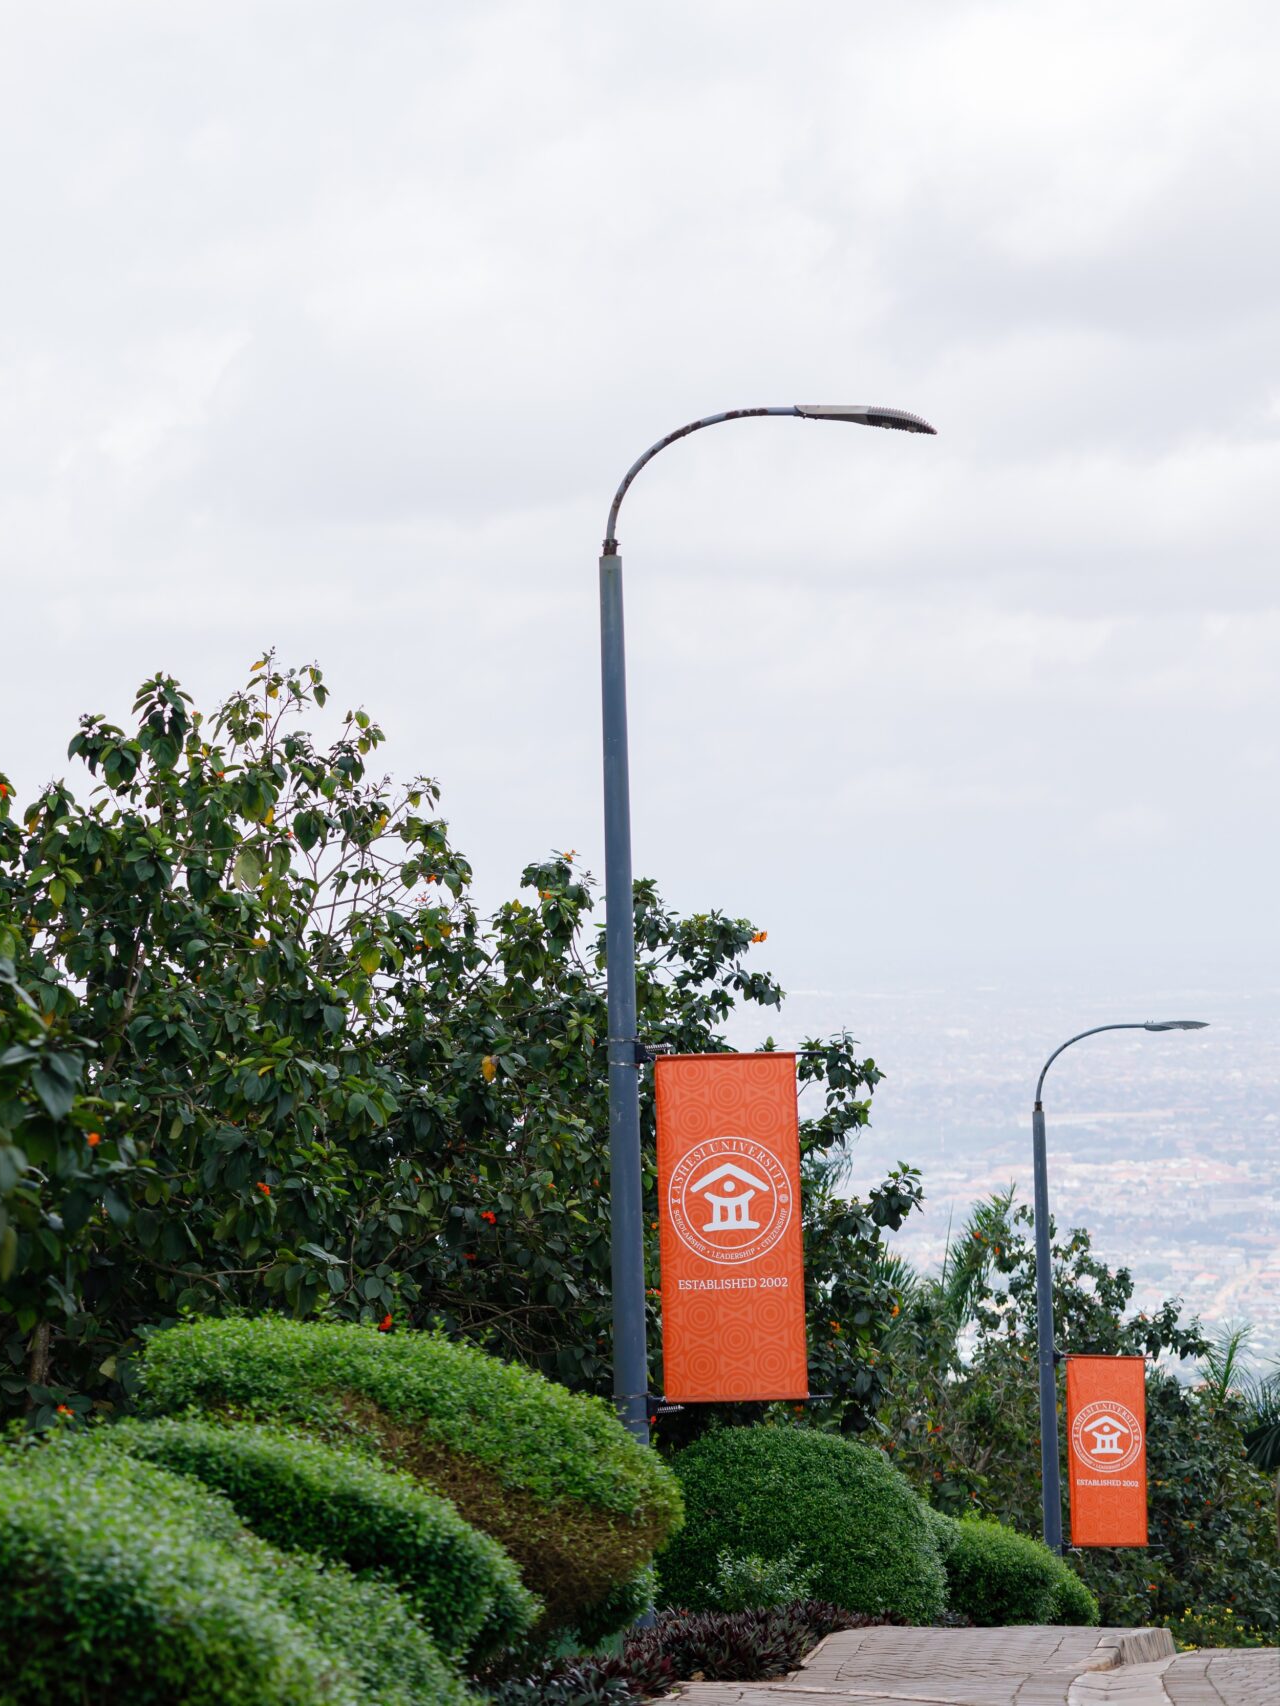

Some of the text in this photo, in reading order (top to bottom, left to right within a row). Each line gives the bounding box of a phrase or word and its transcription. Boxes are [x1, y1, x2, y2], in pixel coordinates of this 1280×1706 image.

[675, 1141, 788, 1194] ASHESI UNIVERSITY
[673, 1207, 788, 1260] SCHOLARSHIP LEADERSHIP CITIZENSHIP
[678, 1277, 789, 1290] ESTABLISHED 2002
[1076, 1479, 1139, 1488] ESTABLISHED 2002
